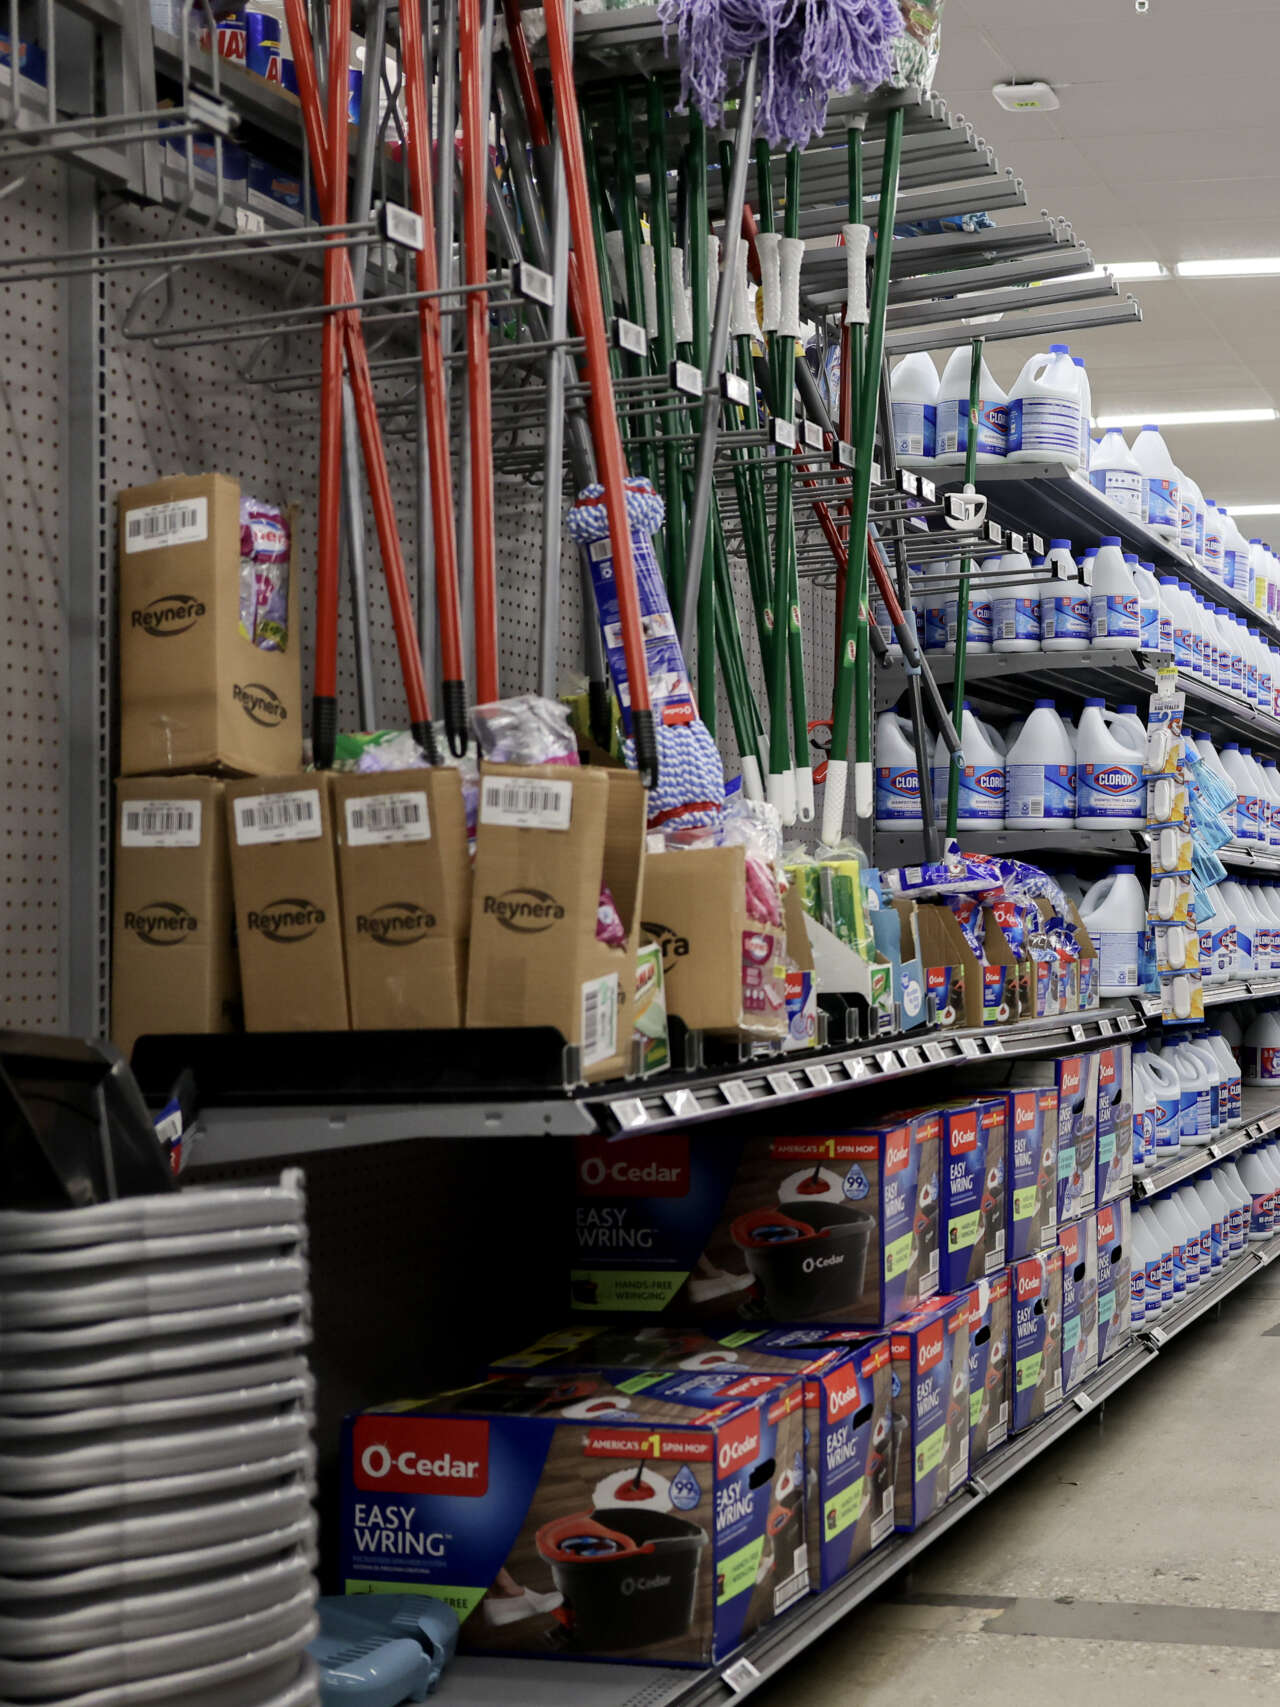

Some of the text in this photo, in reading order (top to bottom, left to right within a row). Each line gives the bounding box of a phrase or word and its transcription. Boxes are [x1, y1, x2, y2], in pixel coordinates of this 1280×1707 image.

[131, 600, 206, 629] Reynera
[232, 683, 288, 720] Reynera
[1098, 774, 1133, 786] CLOROX
[247, 908, 327, 932] Reynera
[483, 896, 566, 921] Reynera
[124, 911, 198, 932] Reynera
[356, 911, 437, 935] Reynera
[1016, 1108, 1035, 1124] O-Cedar
[778, 1145, 818, 1153] AMERICA'S
[819, 1139, 836, 1158] #1
[836, 1145, 854, 1153] SPIN
[951, 1130, 977, 1148] O-Cedar
[1014, 1138, 1027, 1153] EASY
[886, 1146, 910, 1168] O-Cedar
[1014, 1151, 1033, 1169] WRING
[581, 1157, 682, 1185] O-Cedar
[950, 1161, 967, 1180] EASY
[884, 1182, 899, 1201] EASY
[950, 1174, 975, 1195] WRING
[576, 1207, 628, 1227] EASY
[802, 1254, 845, 1273] O-Cedar
[1018, 1276, 1041, 1293] O-Cedar
[1017, 1305, 1032, 1324] EASY
[1017, 1318, 1039, 1339] WRING
[918, 1340, 943, 1367] O-Cedar
[829, 1384, 858, 1414] O-Cedar
[916, 1376, 933, 1401] EASY
[916, 1388, 941, 1418] WRING
[592, 1440, 640, 1451] AMERICA'S
[641, 1434, 661, 1458] #1
[661, 1441, 682, 1453] SPIN
[718, 1433, 758, 1469] O-Cedar
[826, 1425, 849, 1454] EASY
[361, 1443, 481, 1479] O-Cedar
[826, 1437, 857, 1471] WRING
[353, 1503, 416, 1530] EASY
[715, 1493, 754, 1531] WRING
[621, 1574, 673, 1596] O-Cedar
